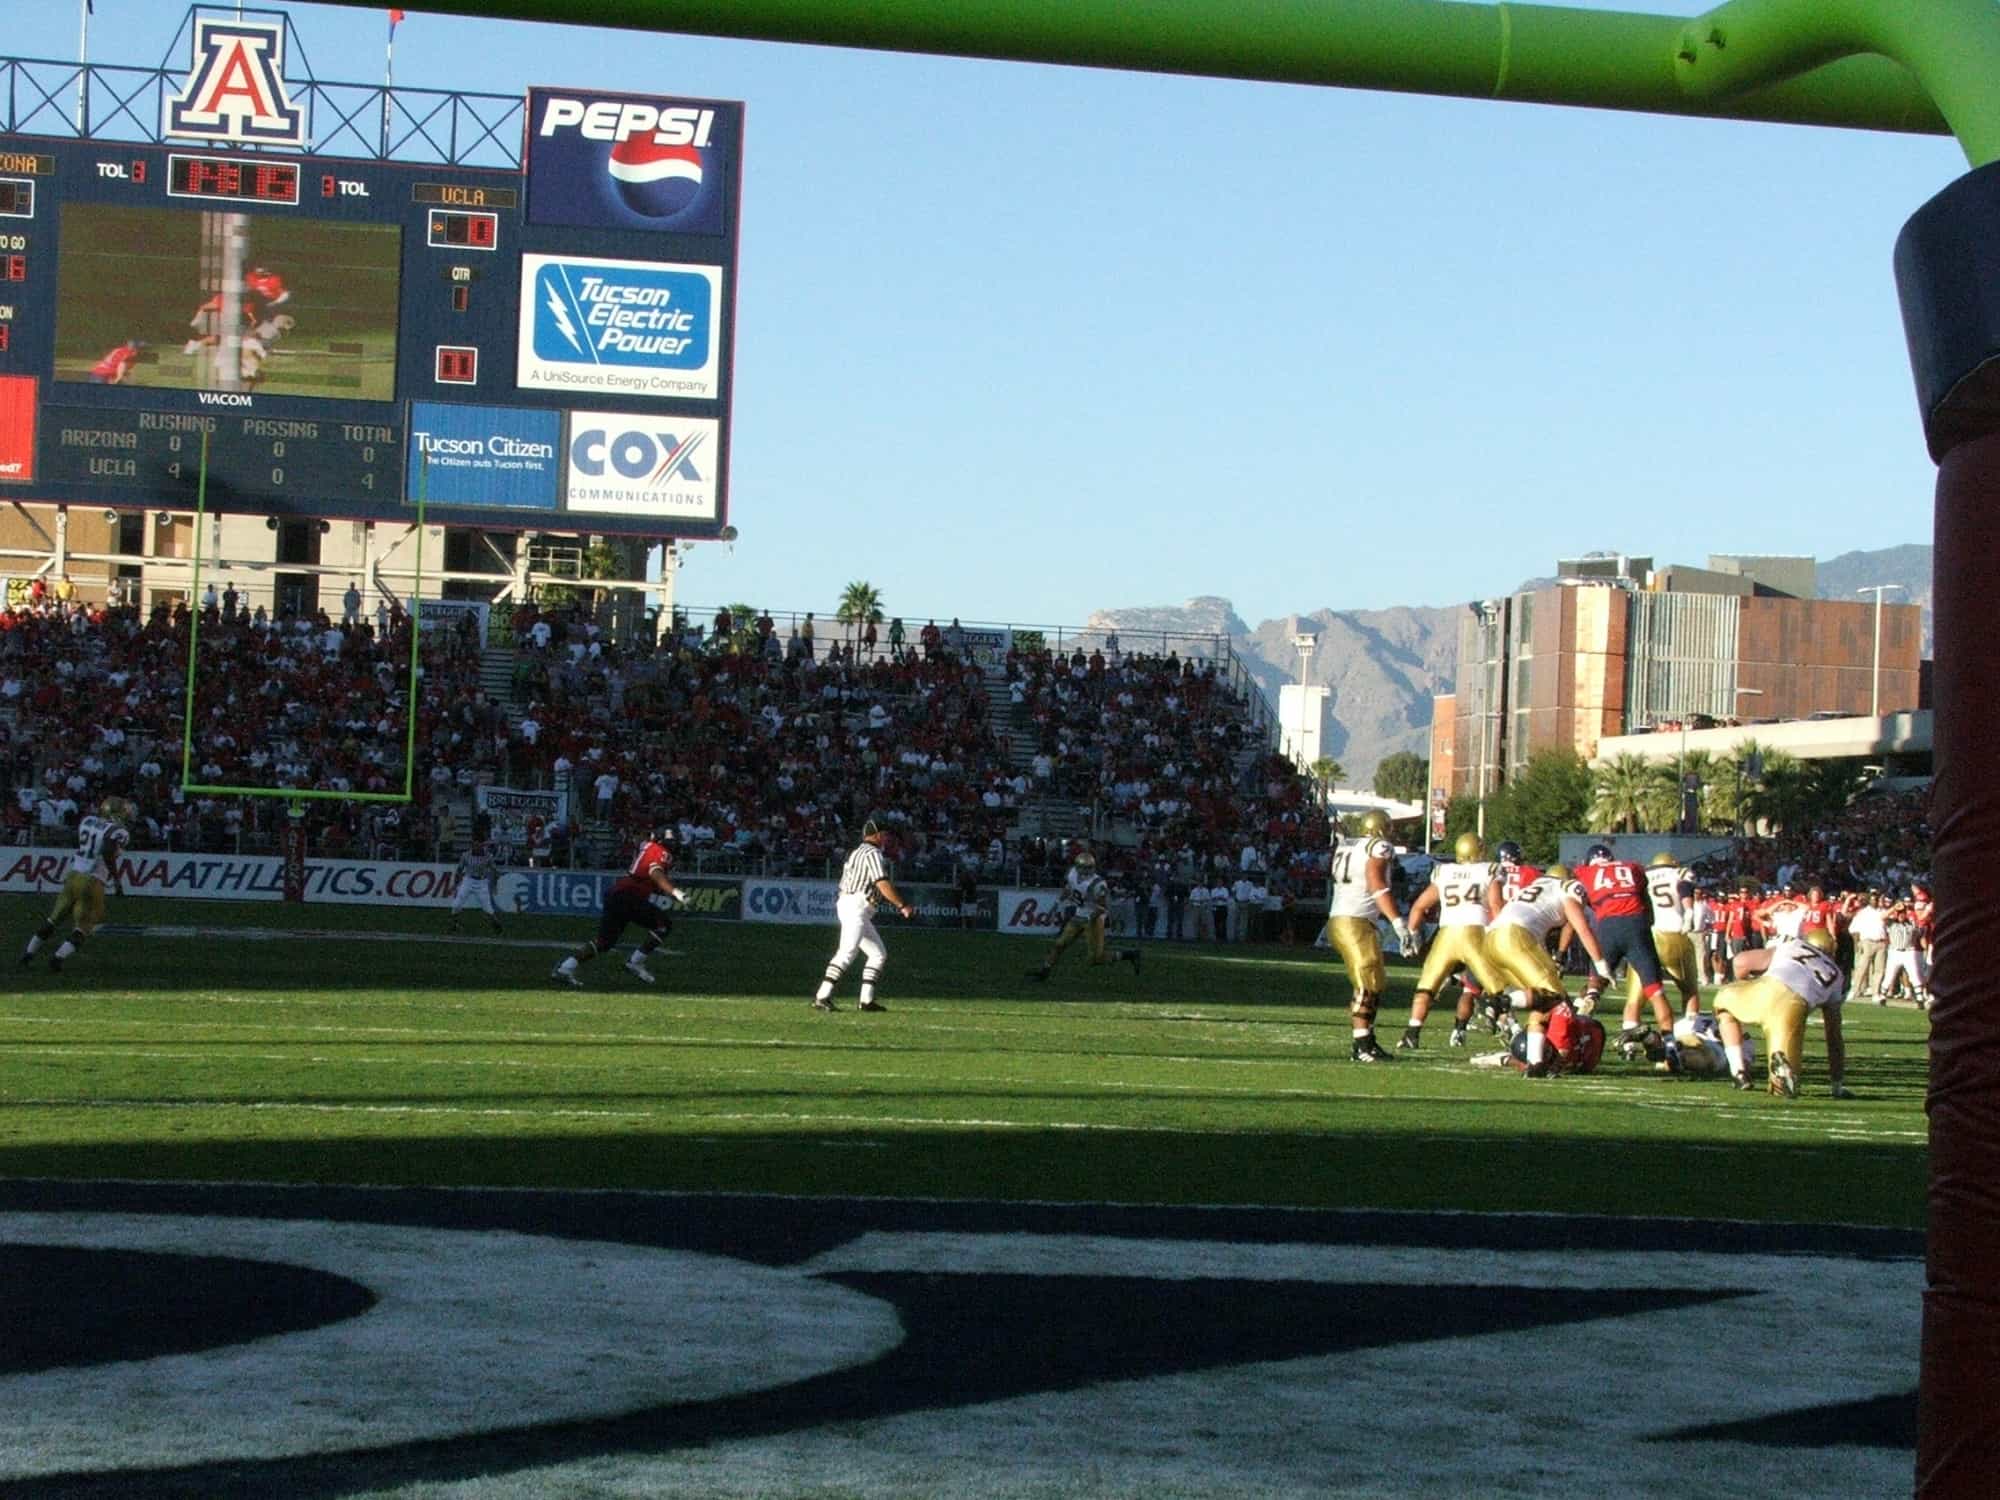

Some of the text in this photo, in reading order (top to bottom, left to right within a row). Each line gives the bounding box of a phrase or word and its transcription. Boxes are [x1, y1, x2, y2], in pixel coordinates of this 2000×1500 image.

[540, 98, 715, 148] PEPSI
[97, 163, 129, 178] TOL
[338, 180, 370, 197] TOL
[442, 187, 485, 205] UCLA
[10, 236, 26, 250] GO
[452, 267, 471, 281] QTR
[579, 277, 670, 307] Tucson
[587, 303, 695, 331] Electric
[597, 328, 693, 355] Power
[530, 370, 709, 393] A UniSource Energy Company
[198, 393, 253, 407] VIACOM
[61, 429, 138, 450] ARIZONA
[139, 412, 397, 444] RUSHING PASSING TOTAL
[413, 432, 553, 459] Tucson Citizen
[571, 429, 708, 485] COX
[89, 457, 137, 477] UCLA
[360, 473, 374, 490] 4
[569, 487, 705, 506] COMMUNICATIONS
[80, 829, 97, 859] 21
[1334, 851, 1352, 884] 71
[1593, 866, 1636, 891] 49
[748, 886, 802, 915] COX
[1444, 883, 1482, 908] 54
[1653, 883, 1674, 908] 5
